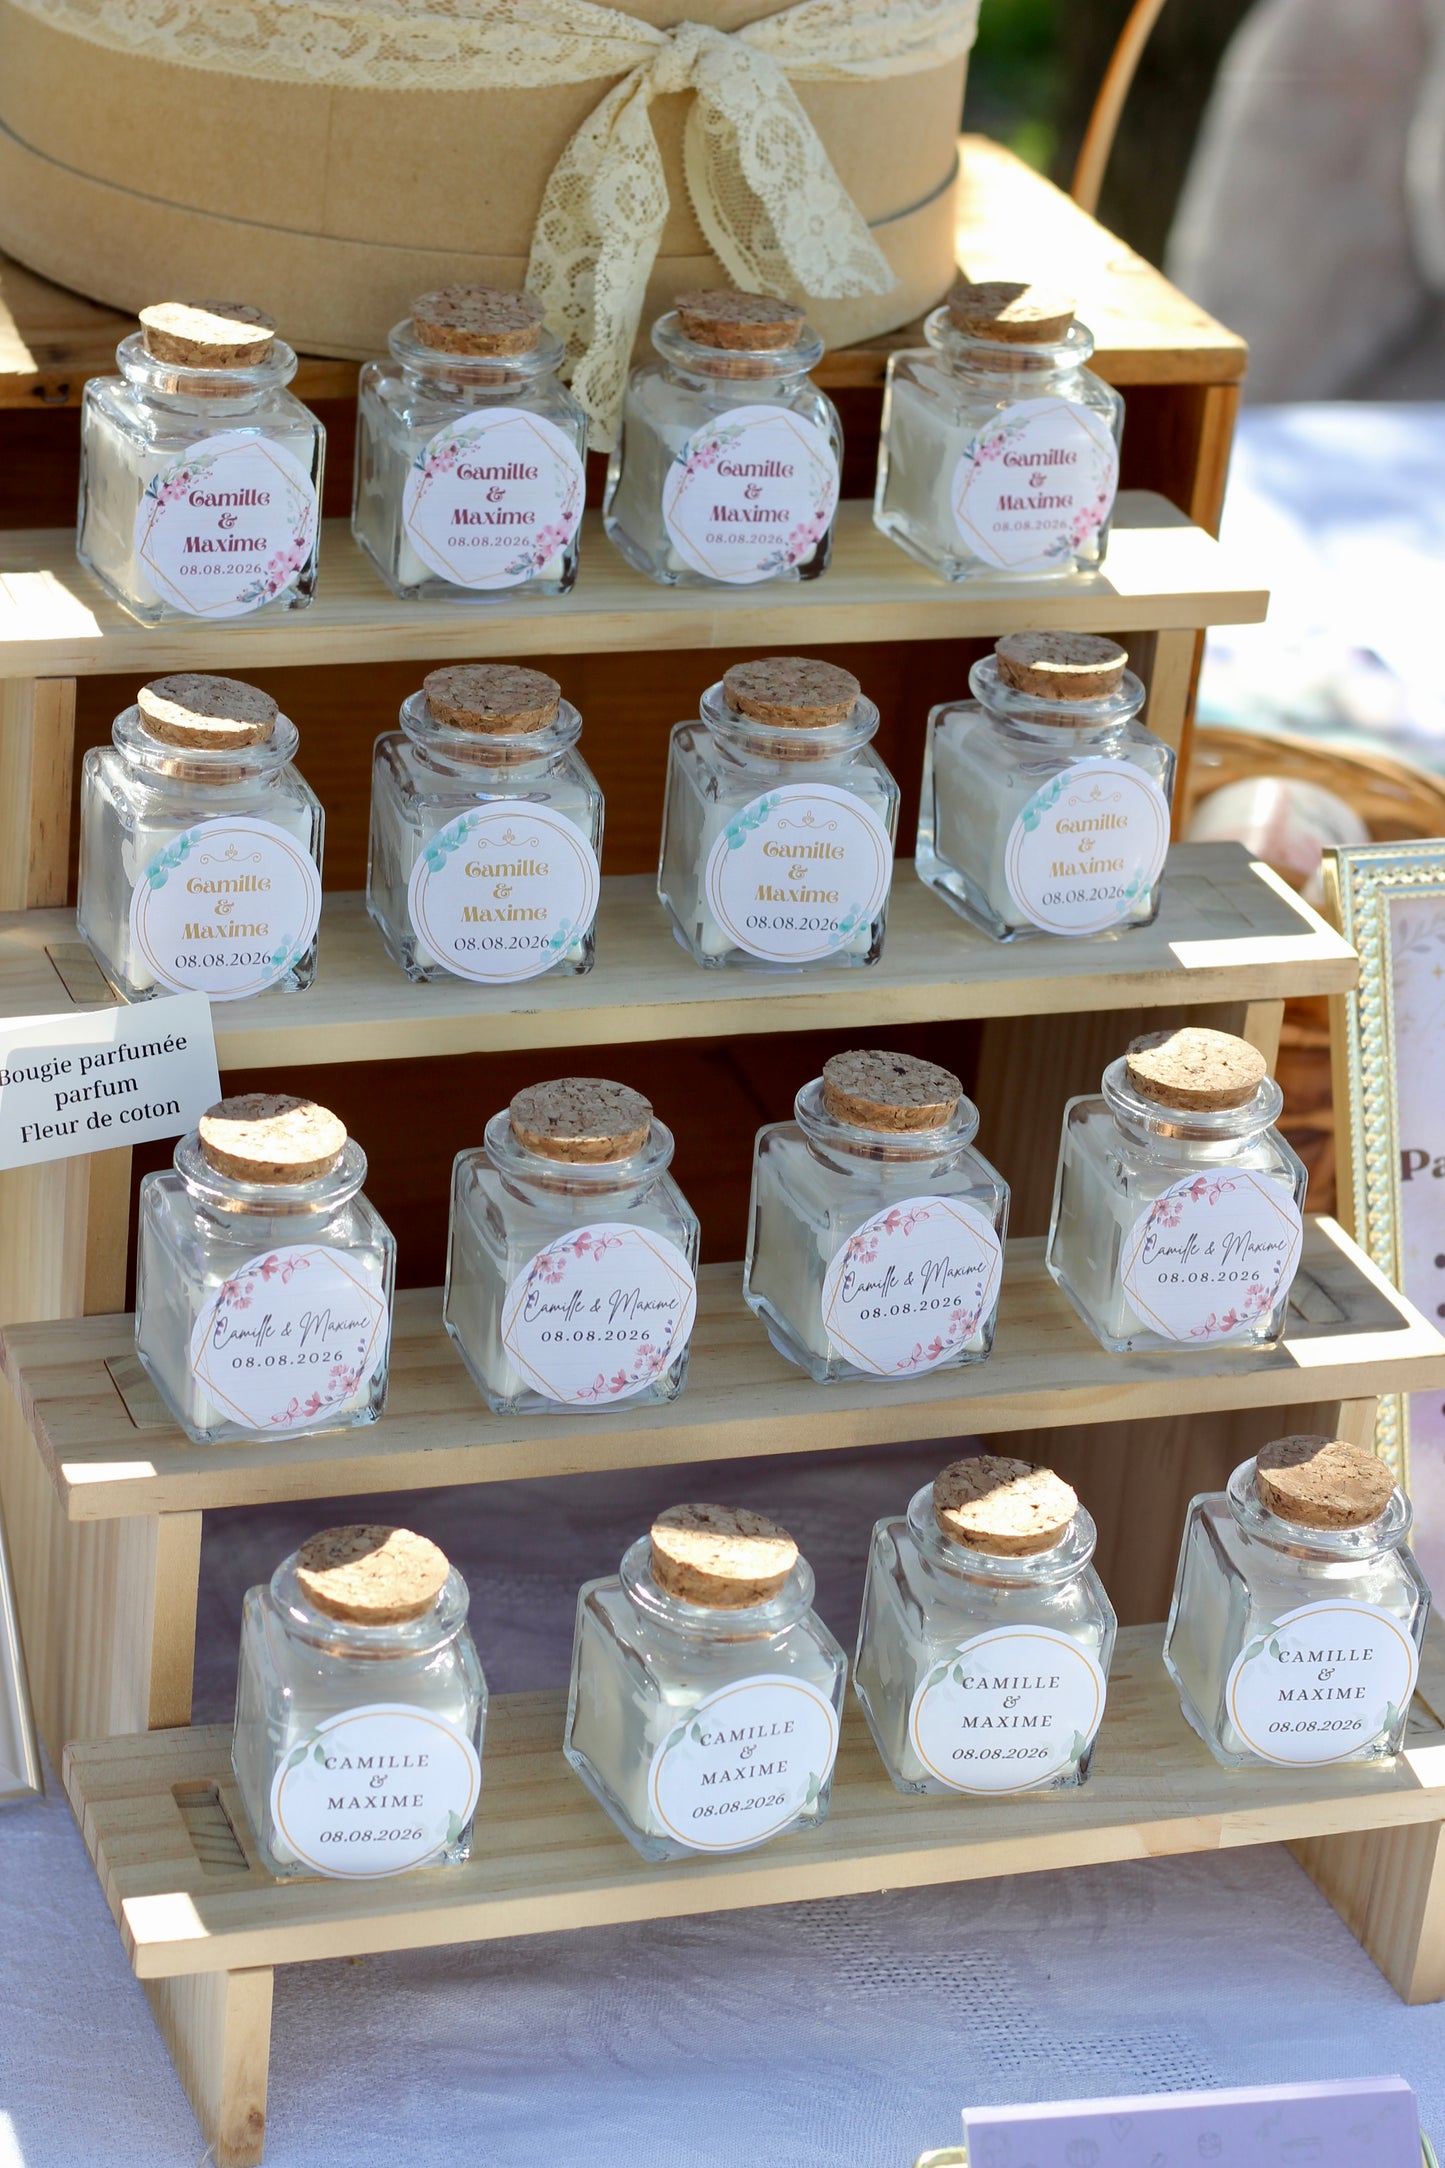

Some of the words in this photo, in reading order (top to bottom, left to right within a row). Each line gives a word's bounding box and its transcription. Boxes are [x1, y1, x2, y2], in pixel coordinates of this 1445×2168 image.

[1003, 449, 1077, 467] Camille
[456, 463, 538, 480] Camille
[717, 459, 794, 478] Camille
[1029, 472, 1047, 487] &
[189, 488, 271, 507] Camille
[486, 486, 506, 502] &
[744, 483, 762, 500] &
[996, 492, 1073, 511] Maxime
[218, 513, 238, 529] &
[451, 508, 535, 525] Maxime
[709, 505, 789, 522] Maxime
[992, 521, 1068, 532] 08.08.2026
[183, 534, 267, 553] Maxime
[448, 536, 530, 547] 08.08.2026
[706, 533, 783, 544] 08.08.2026
[179, 564, 262, 576] 08.08.2026
[1056, 813, 1128, 834] Camille
[763, 841, 845, 860] Camille
[1078, 837, 1095, 853] &
[465, 859, 549, 878] Camille
[788, 864, 808, 880] &
[1049, 857, 1124, 878] Maxime
[186, 874, 271, 894] Camille
[493, 883, 513, 899] &
[754, 885, 839, 904] Maxime
[1042, 886, 1125, 905] 08.08.2026
[214, 899, 235, 916] &
[461, 904, 547, 922] Maxime
[182, 920, 269, 940] Maxime
[746, 915, 839, 931] 08.08.2026
[454, 934, 549, 951] 08.08.2026
[175, 950, 271, 969] 08.08.2026
[0, 1057, 72, 1087] Bougie
[79, 1034, 188, 1075] parfumée
[54, 1077, 139, 1111] parfum
[20, 1118, 79, 1144] Fleur
[86, 1111, 113, 1130] de
[120, 1099, 181, 1124] coton
[1141, 1233, 1200, 1265] Camille
[1204, 1241, 1215, 1255] &
[1222, 1230, 1287, 1266] Maxime
[841, 1265, 899, 1303] Camille
[904, 1271, 915, 1286] &
[921, 1256, 987, 1295] Maxime
[1158, 1270, 1260, 1283] 08.08.2026
[523, 1290, 585, 1323] Camille
[589, 1298, 601, 1313] &
[608, 1287, 679, 1324] Maxime
[860, 1295, 962, 1320] 08.08.2026
[213, 1314, 276, 1350] Camille
[280, 1322, 292, 1337] &
[299, 1308, 370, 1347] Maxime
[541, 1329, 650, 1342] 08.08.2026
[232, 1350, 343, 1369] 08.08.2026
[1278, 1648, 1374, 1664] CAMILLE
[1318, 1667, 1335, 1681] &
[962, 1676, 1060, 1690] CAMILLE
[1003, 1695, 1021, 1709] &
[1278, 1687, 1366, 1701] MAXIME
[961, 1715, 1053, 1729] MAXIME
[1268, 1719, 1362, 1733] 08.08.2026
[700, 1720, 795, 1747] CAMILLE
[739, 1744, 757, 1760] &
[952, 1747, 1048, 1760] 08.08.2026
[324, 1754, 430, 1771] CAMILLE
[369, 1774, 388, 1788] &
[700, 1760, 788, 1786] MAXIME
[327, 1794, 424, 1810] MAXIME
[692, 1793, 785, 1819] 08.08.2026
[319, 1828, 423, 1843] 08.08.2026
